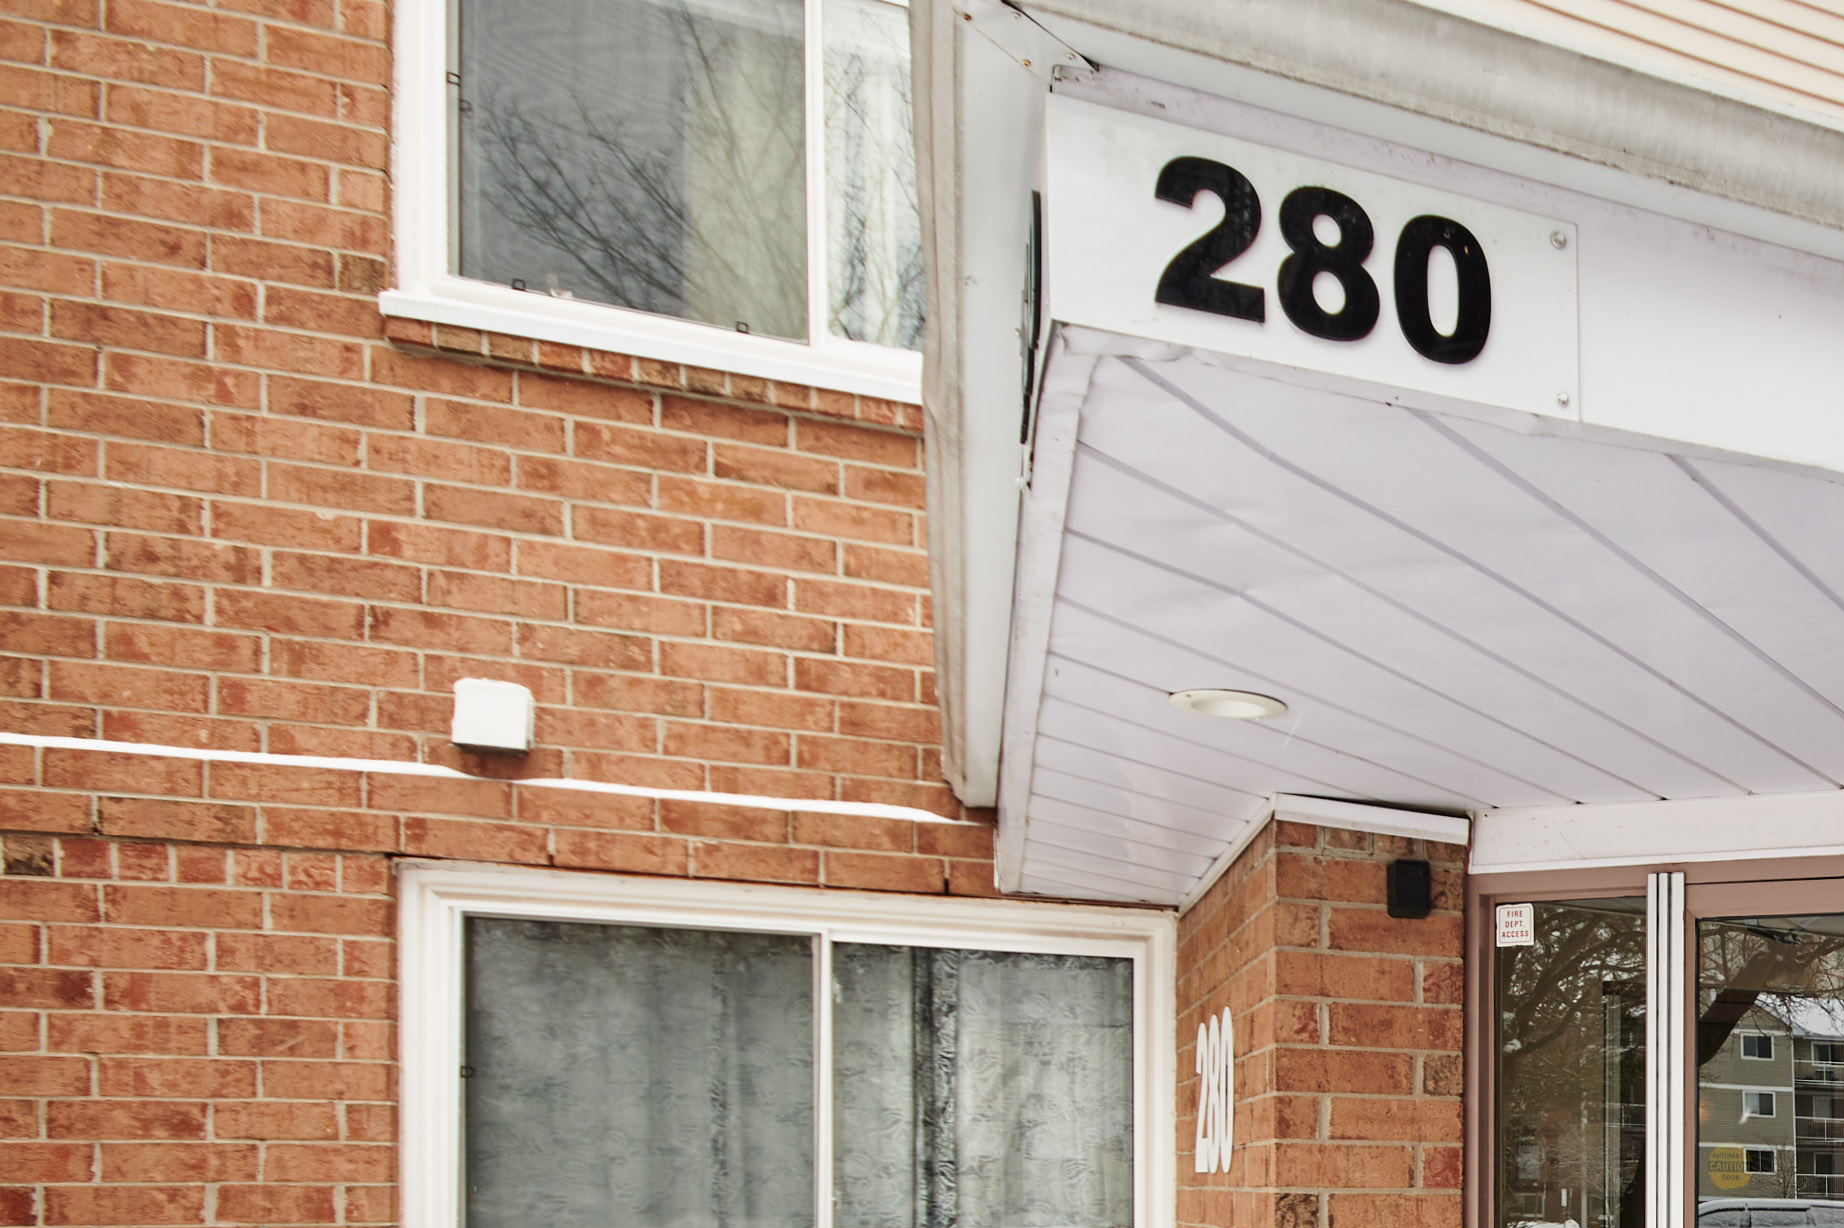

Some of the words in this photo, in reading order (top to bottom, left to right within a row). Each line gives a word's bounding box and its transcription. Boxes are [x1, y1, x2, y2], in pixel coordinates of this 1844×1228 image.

[1154, 155, 1492, 365] 280
[1501, 930, 1529, 938] ACCESS
[1195, 1006, 1234, 1174] 280
